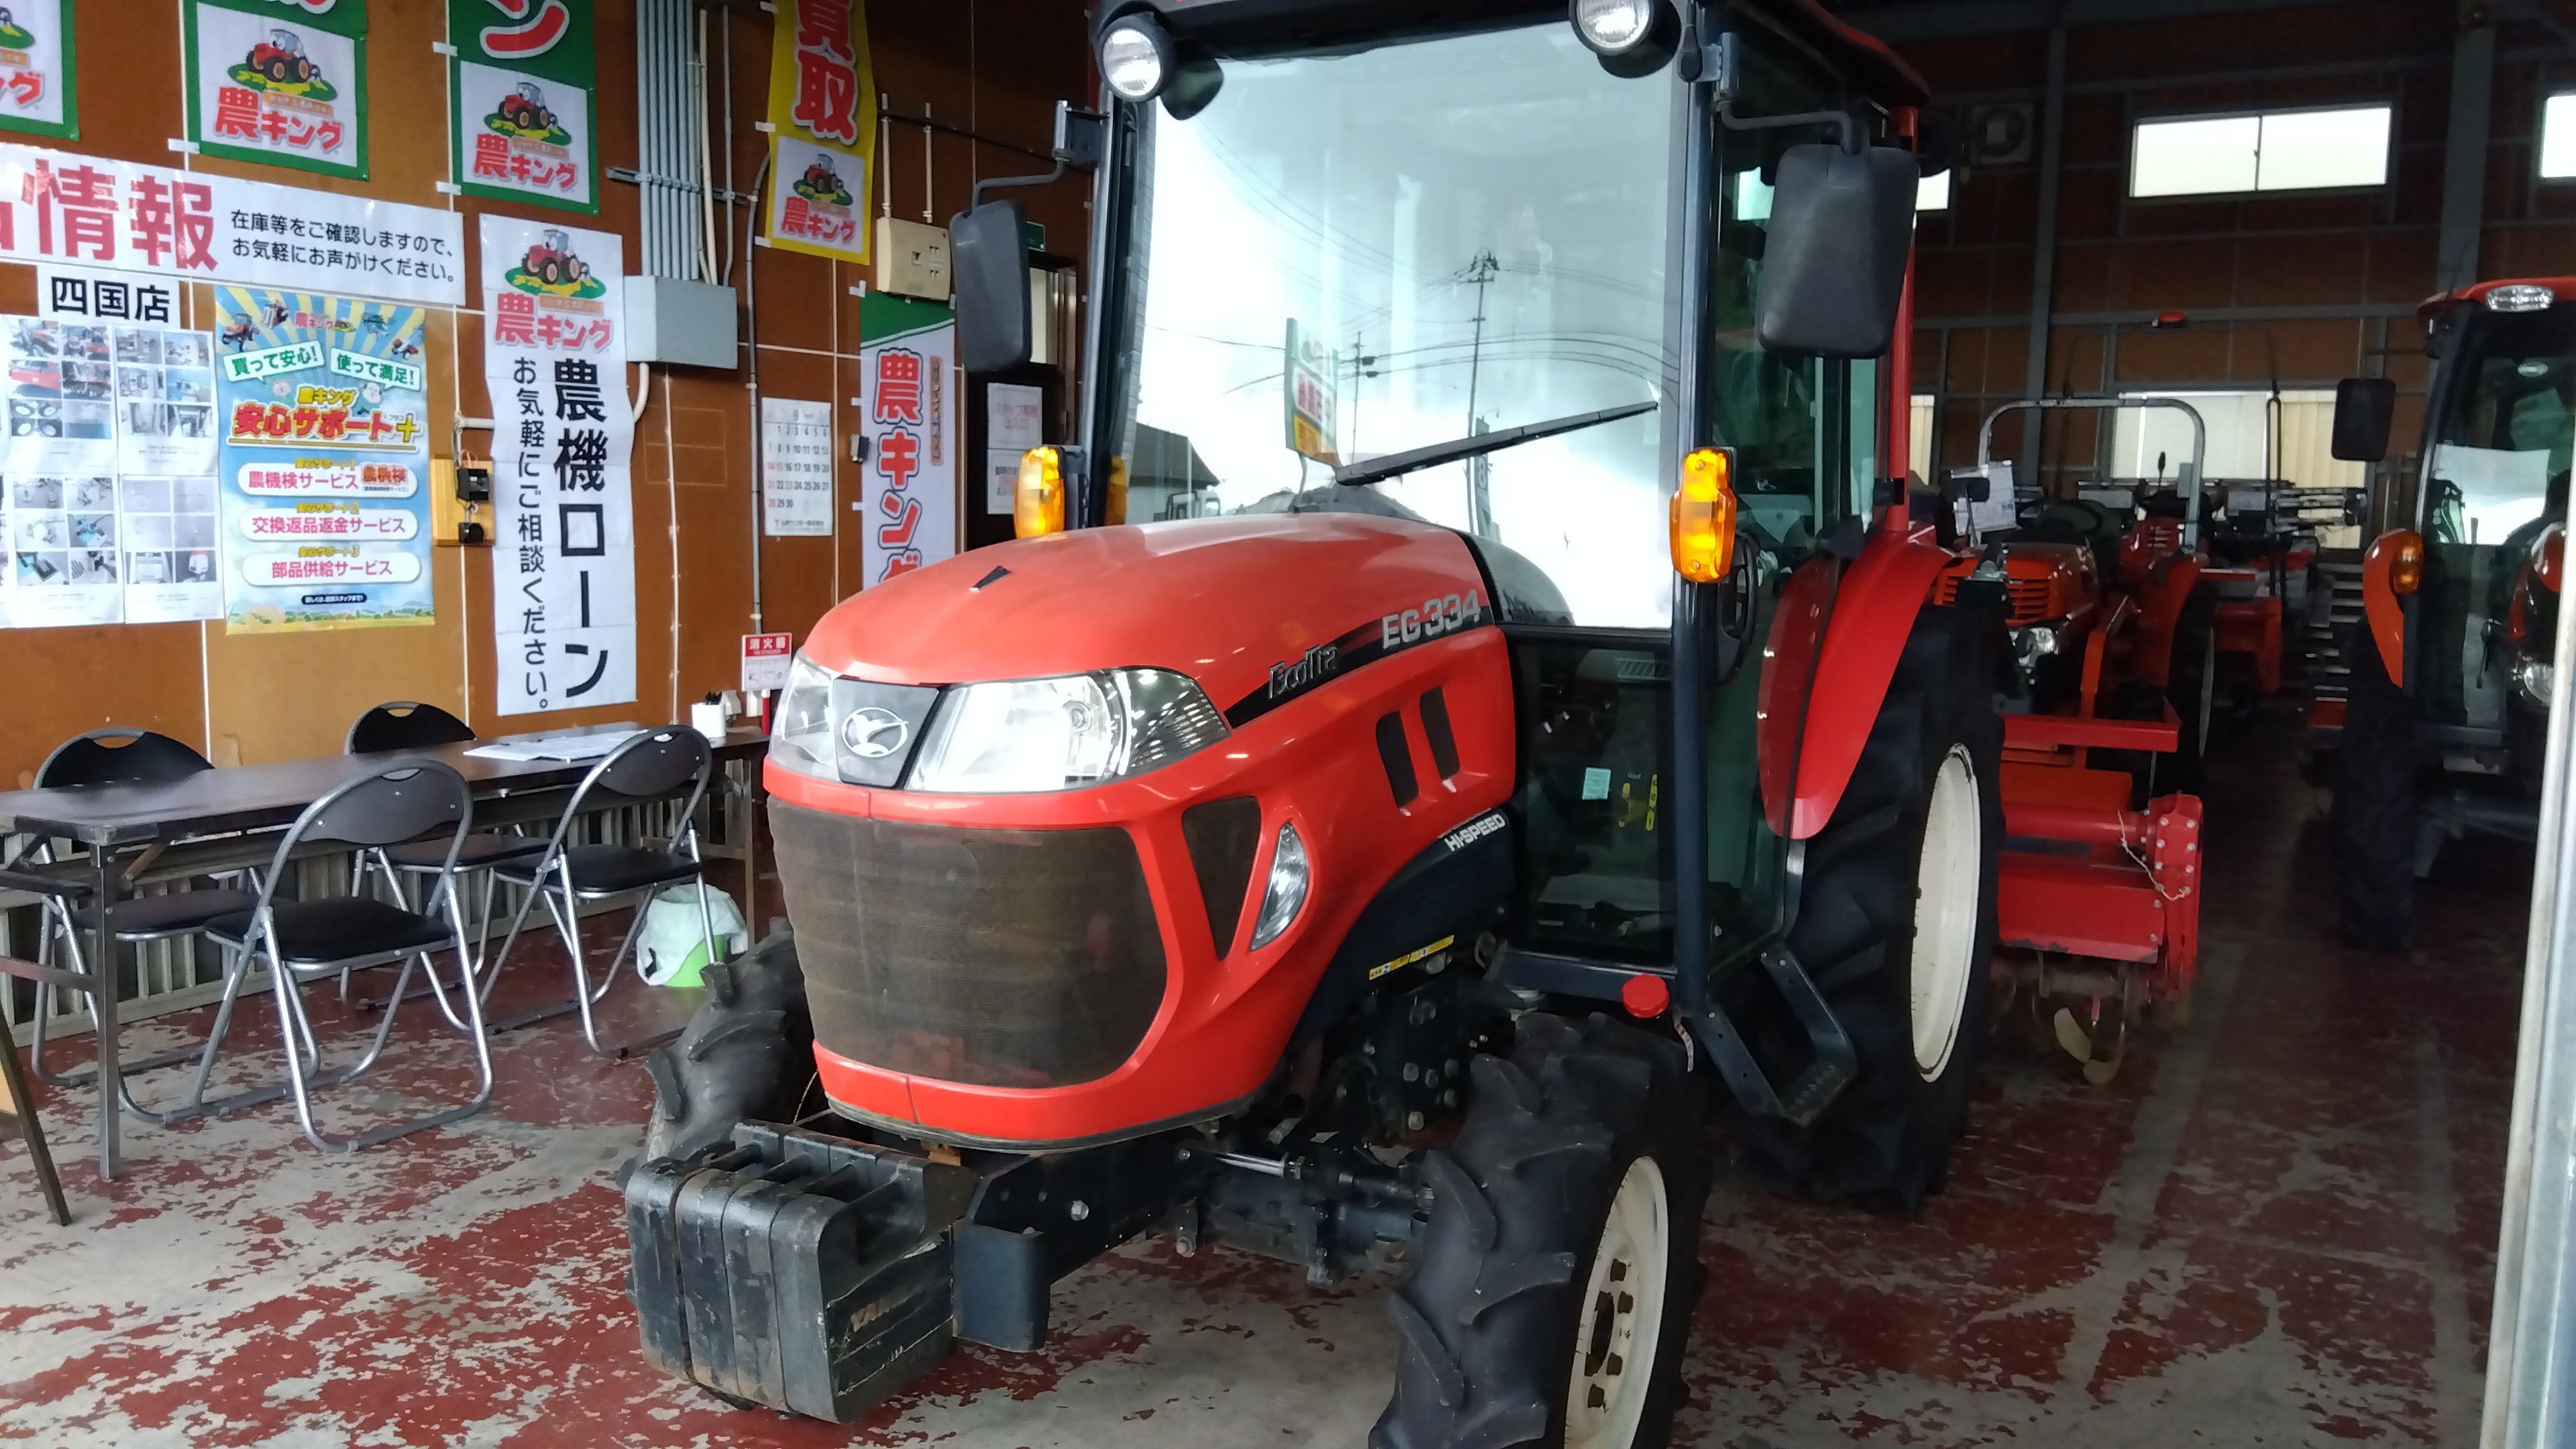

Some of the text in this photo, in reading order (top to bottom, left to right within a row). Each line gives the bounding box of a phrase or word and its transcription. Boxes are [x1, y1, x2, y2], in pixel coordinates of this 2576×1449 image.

[0, 71, 41, 105] グ
[215, 87, 341, 150] 農キング
[474, 133, 576, 189] 農キング
[0, 158, 218, 271] 情報
[231, 209, 453, 257] 在庫等をご確認しますので、
[782, 197, 854, 242] 農キング
[232, 237, 454, 282] お気軽にお声がけください。
[51, 276, 170, 323] 四国店
[494, 292, 612, 350] 農キング
[248, 470, 360, 490] 農機検サービス
[252, 516, 407, 534] 交換返品返金サービス
[513, 356, 549, 708] お気軽にご相談ください。
[553, 358, 609, 698] 農機ローン
[272, 560, 393, 579] 部品供給サービス
